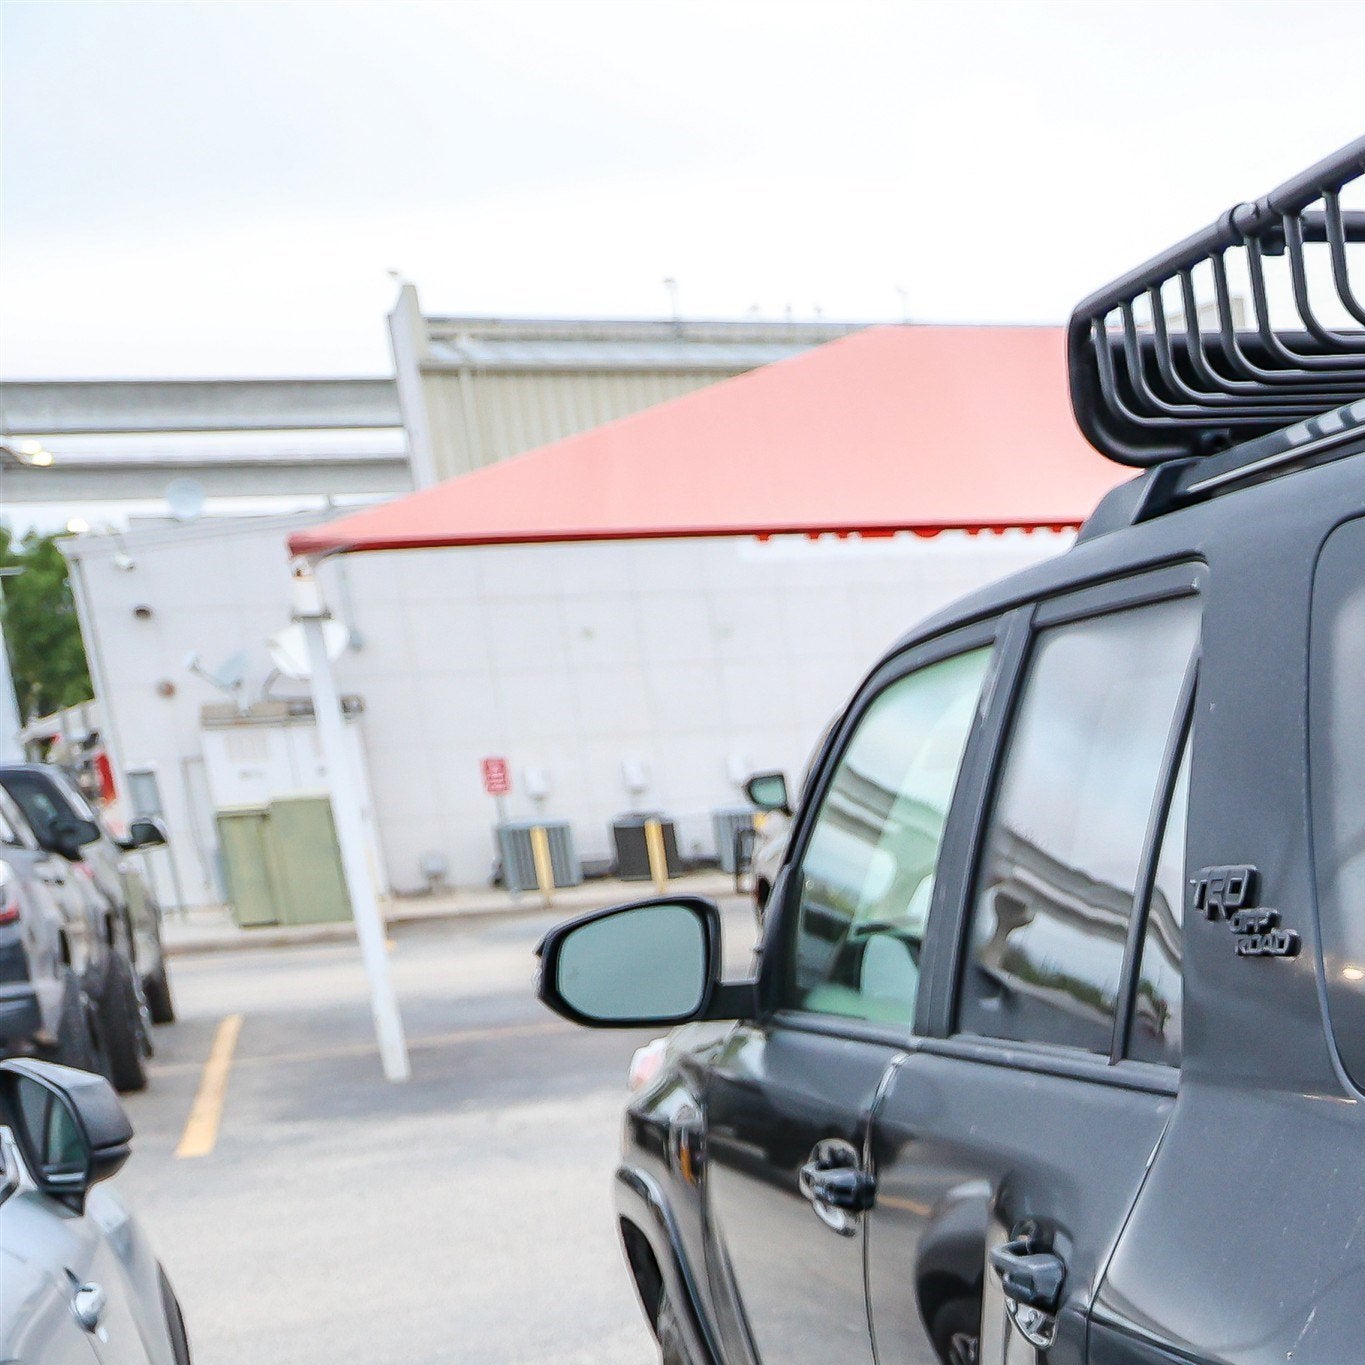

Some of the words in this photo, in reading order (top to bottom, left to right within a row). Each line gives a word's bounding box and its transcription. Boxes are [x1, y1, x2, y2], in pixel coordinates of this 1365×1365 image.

[1190, 865, 1258, 923] TRD
[1230, 908, 1279, 934] OFF
[1235, 929, 1300, 957] ROAD
